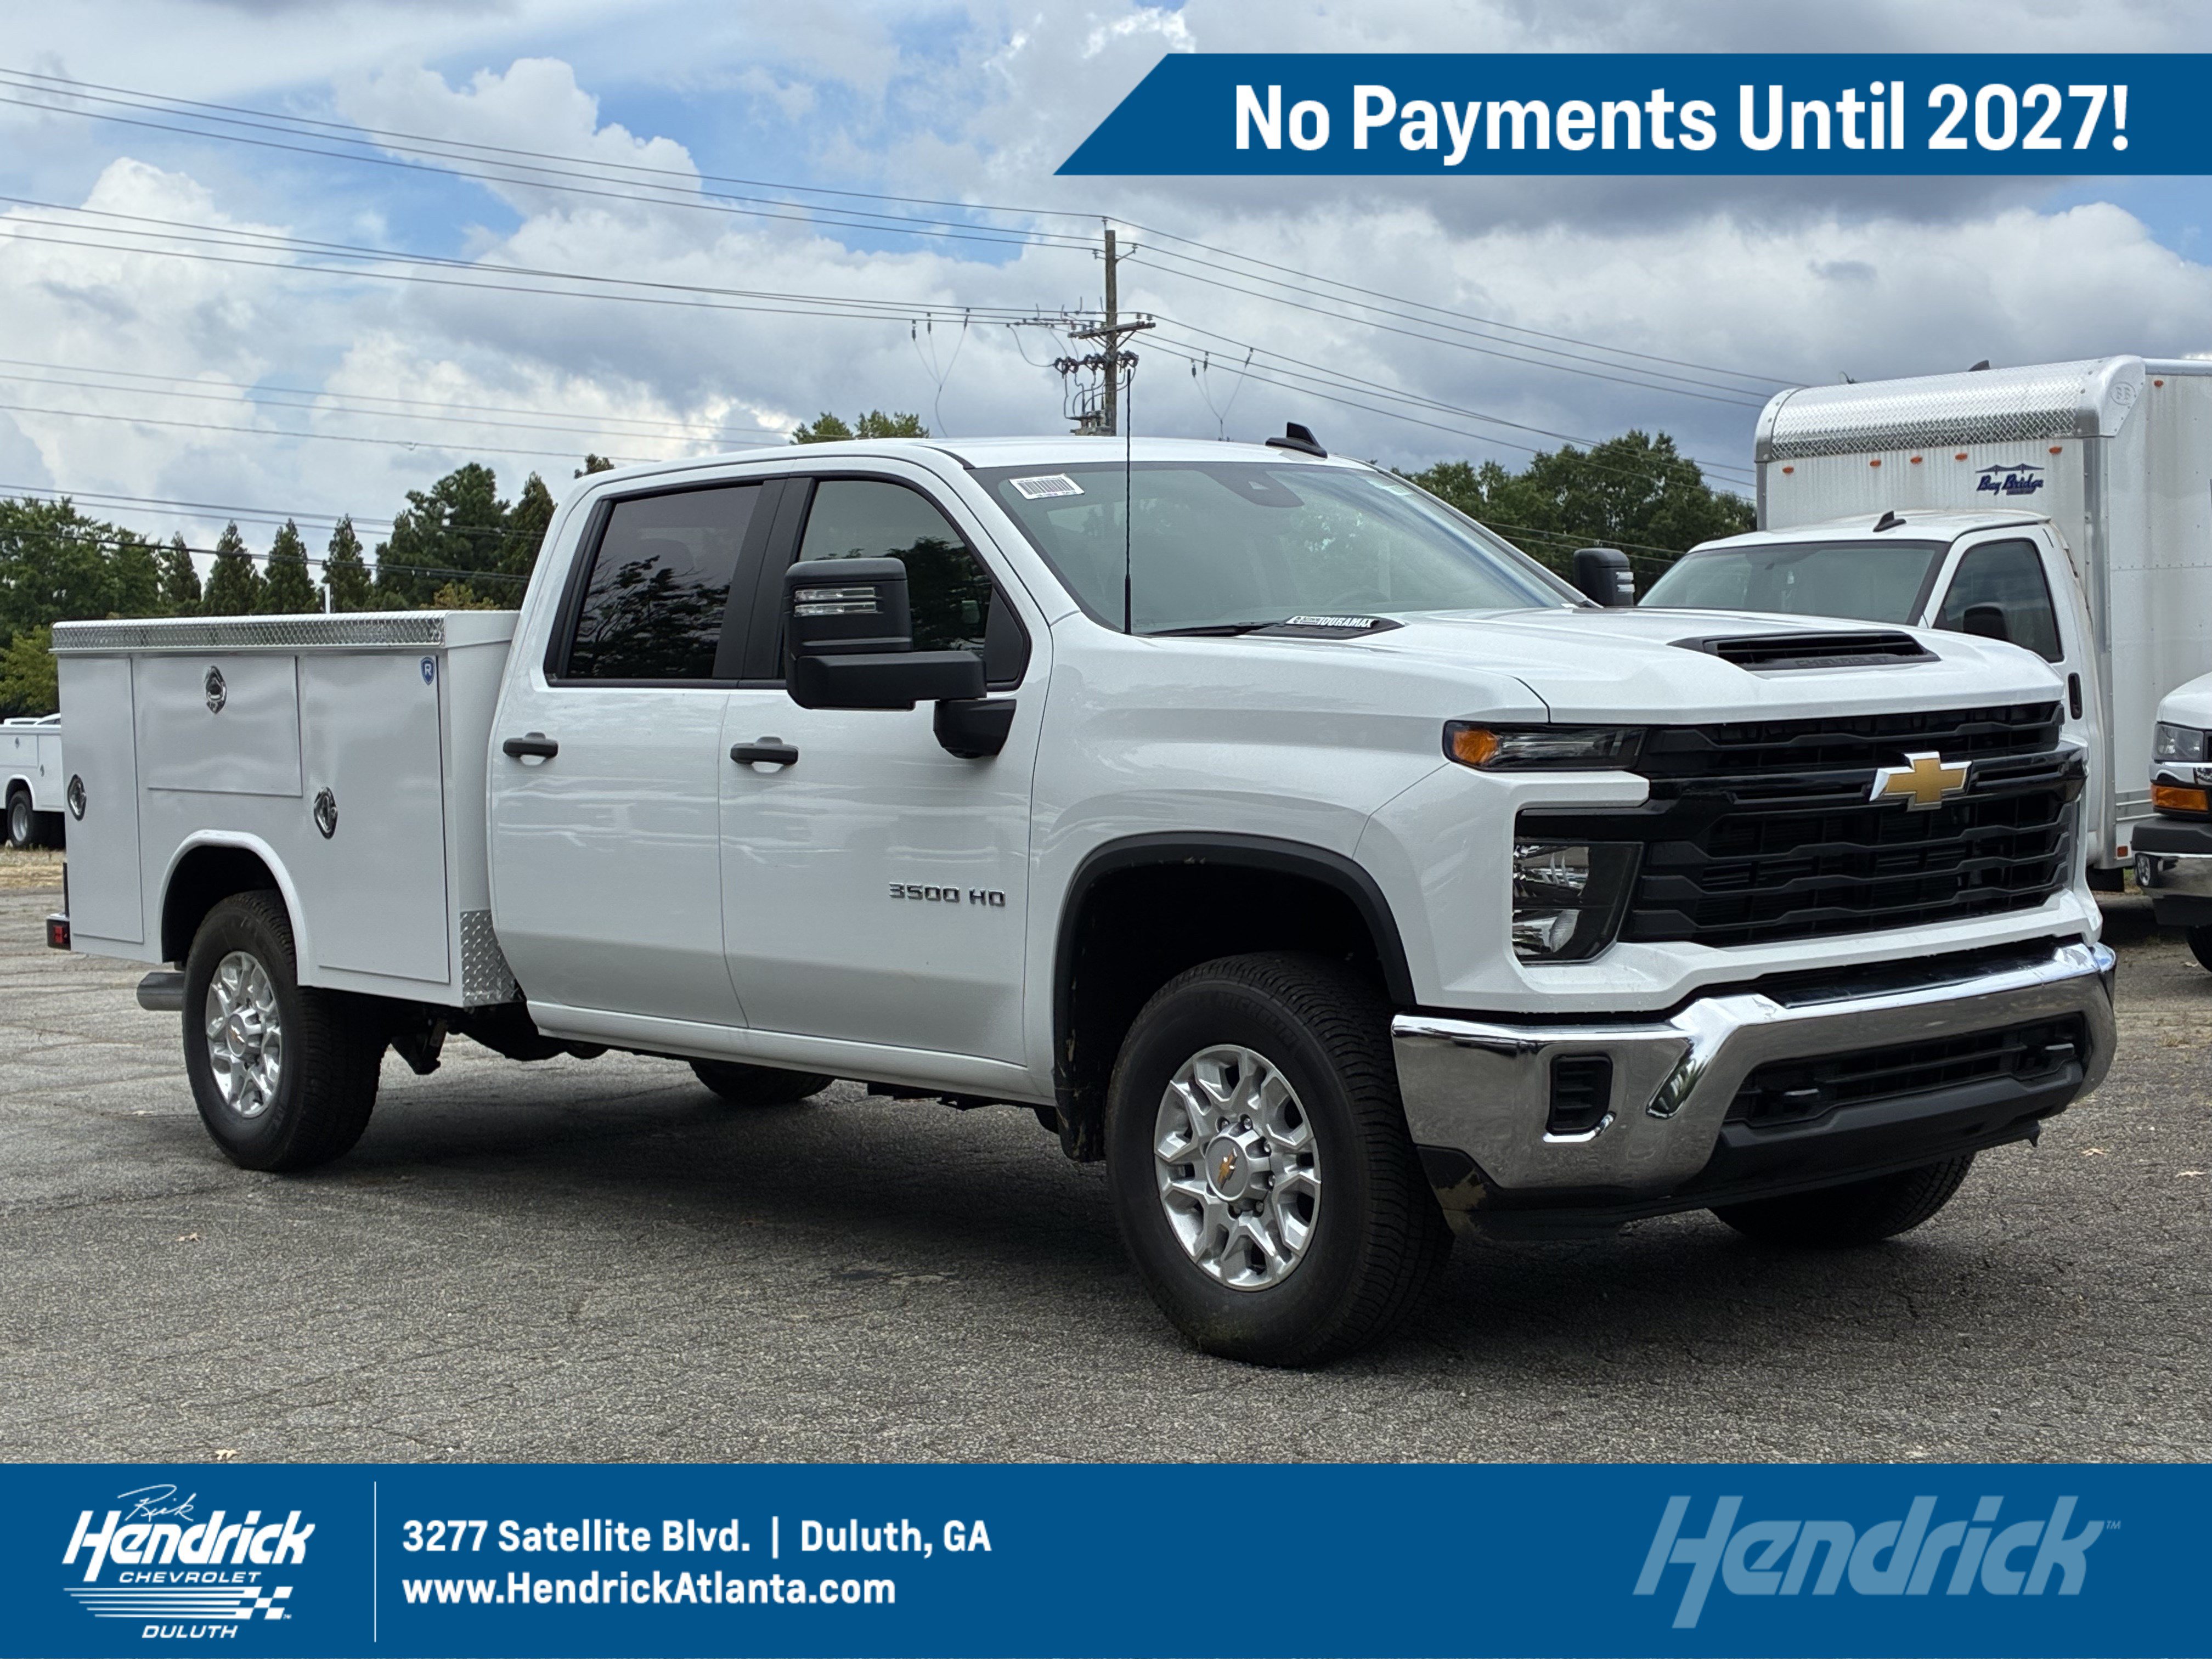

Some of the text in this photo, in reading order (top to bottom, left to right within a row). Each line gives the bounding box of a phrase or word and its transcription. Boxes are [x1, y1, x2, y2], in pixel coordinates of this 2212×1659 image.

[1976, 473, 2044, 495] Bay Bridge
[1319, 617, 1374, 628] DURAMAX
[424, 663, 432, 676] R
[889, 882, 1006, 906] 3500 HD
